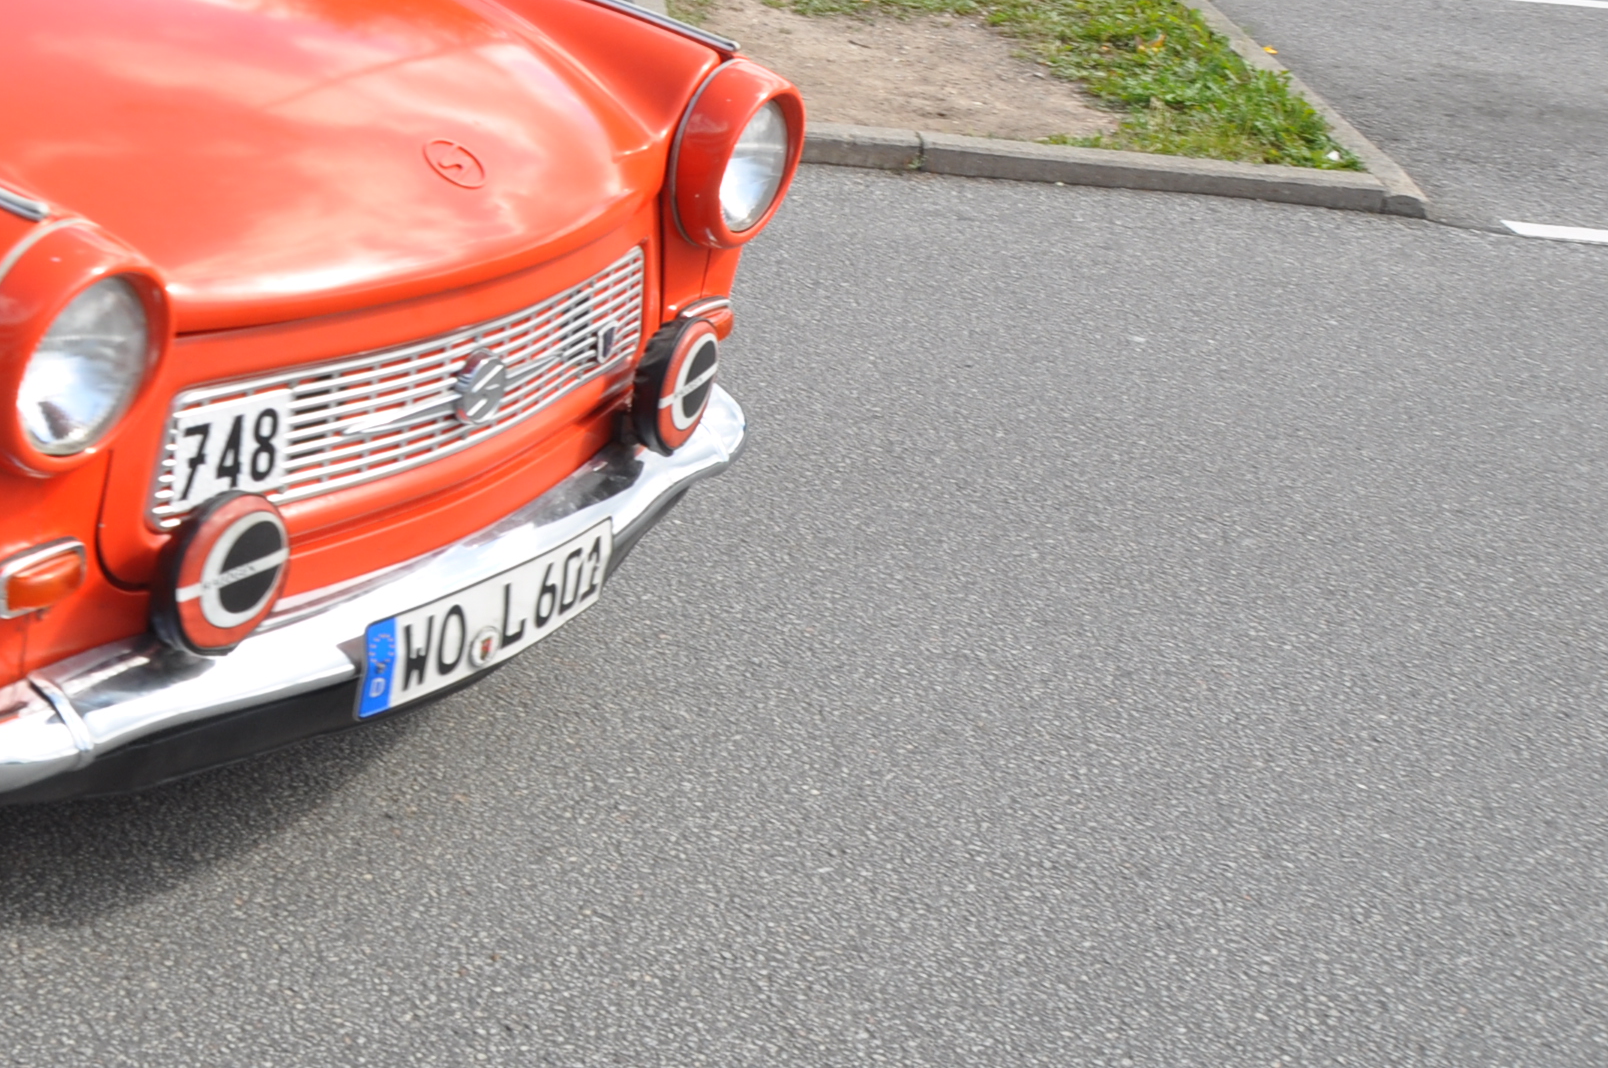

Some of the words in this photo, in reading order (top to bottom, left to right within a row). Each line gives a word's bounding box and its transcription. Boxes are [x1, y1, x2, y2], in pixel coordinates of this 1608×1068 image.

[179, 407, 278, 501] 748
[369, 677, 386, 698] D
[402, 604, 467, 691] WO
